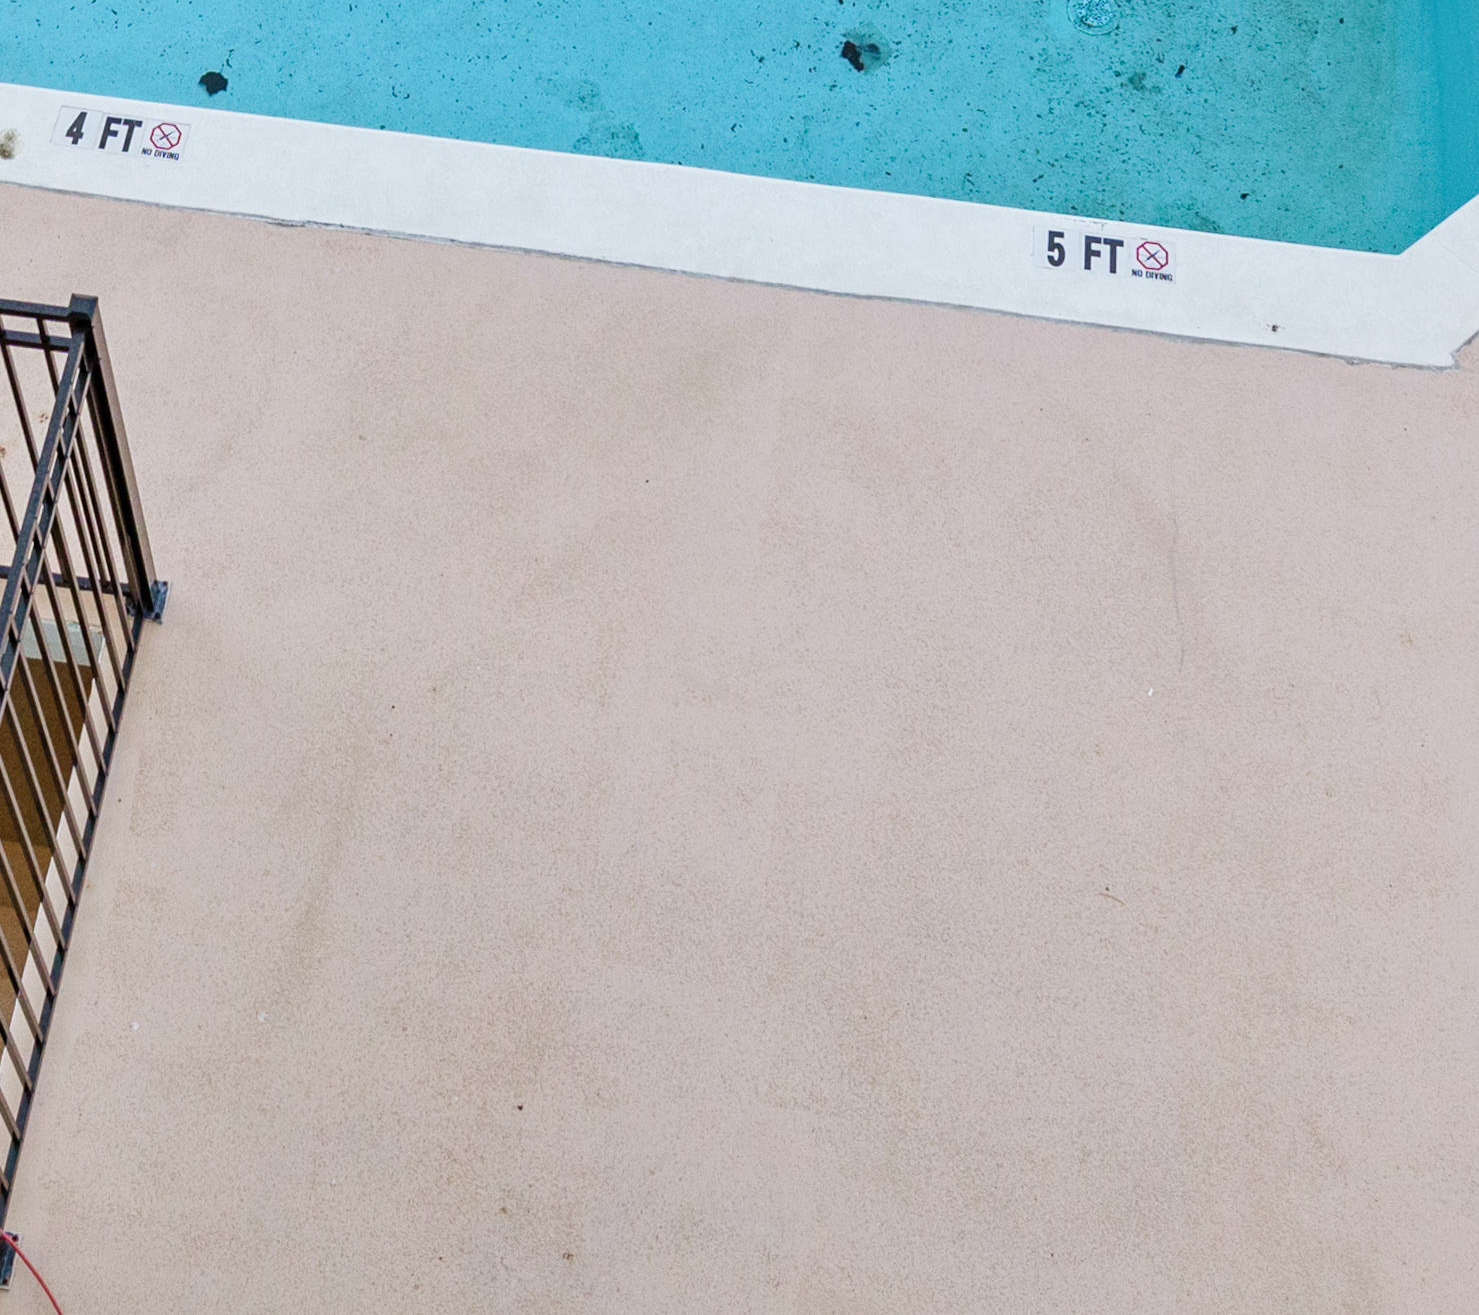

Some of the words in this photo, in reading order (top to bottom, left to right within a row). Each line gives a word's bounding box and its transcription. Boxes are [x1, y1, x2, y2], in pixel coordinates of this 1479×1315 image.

[65, 111, 88, 145] 4
[98, 116, 143, 153] FT
[141, 147, 152, 155] NO
[154, 151, 180, 161] DIVING
[1046, 230, 1066, 267] 5
[1084, 235, 1124, 274] FT
[1132, 269, 1143, 278] NO
[1145, 271, 1173, 282] DIVING
